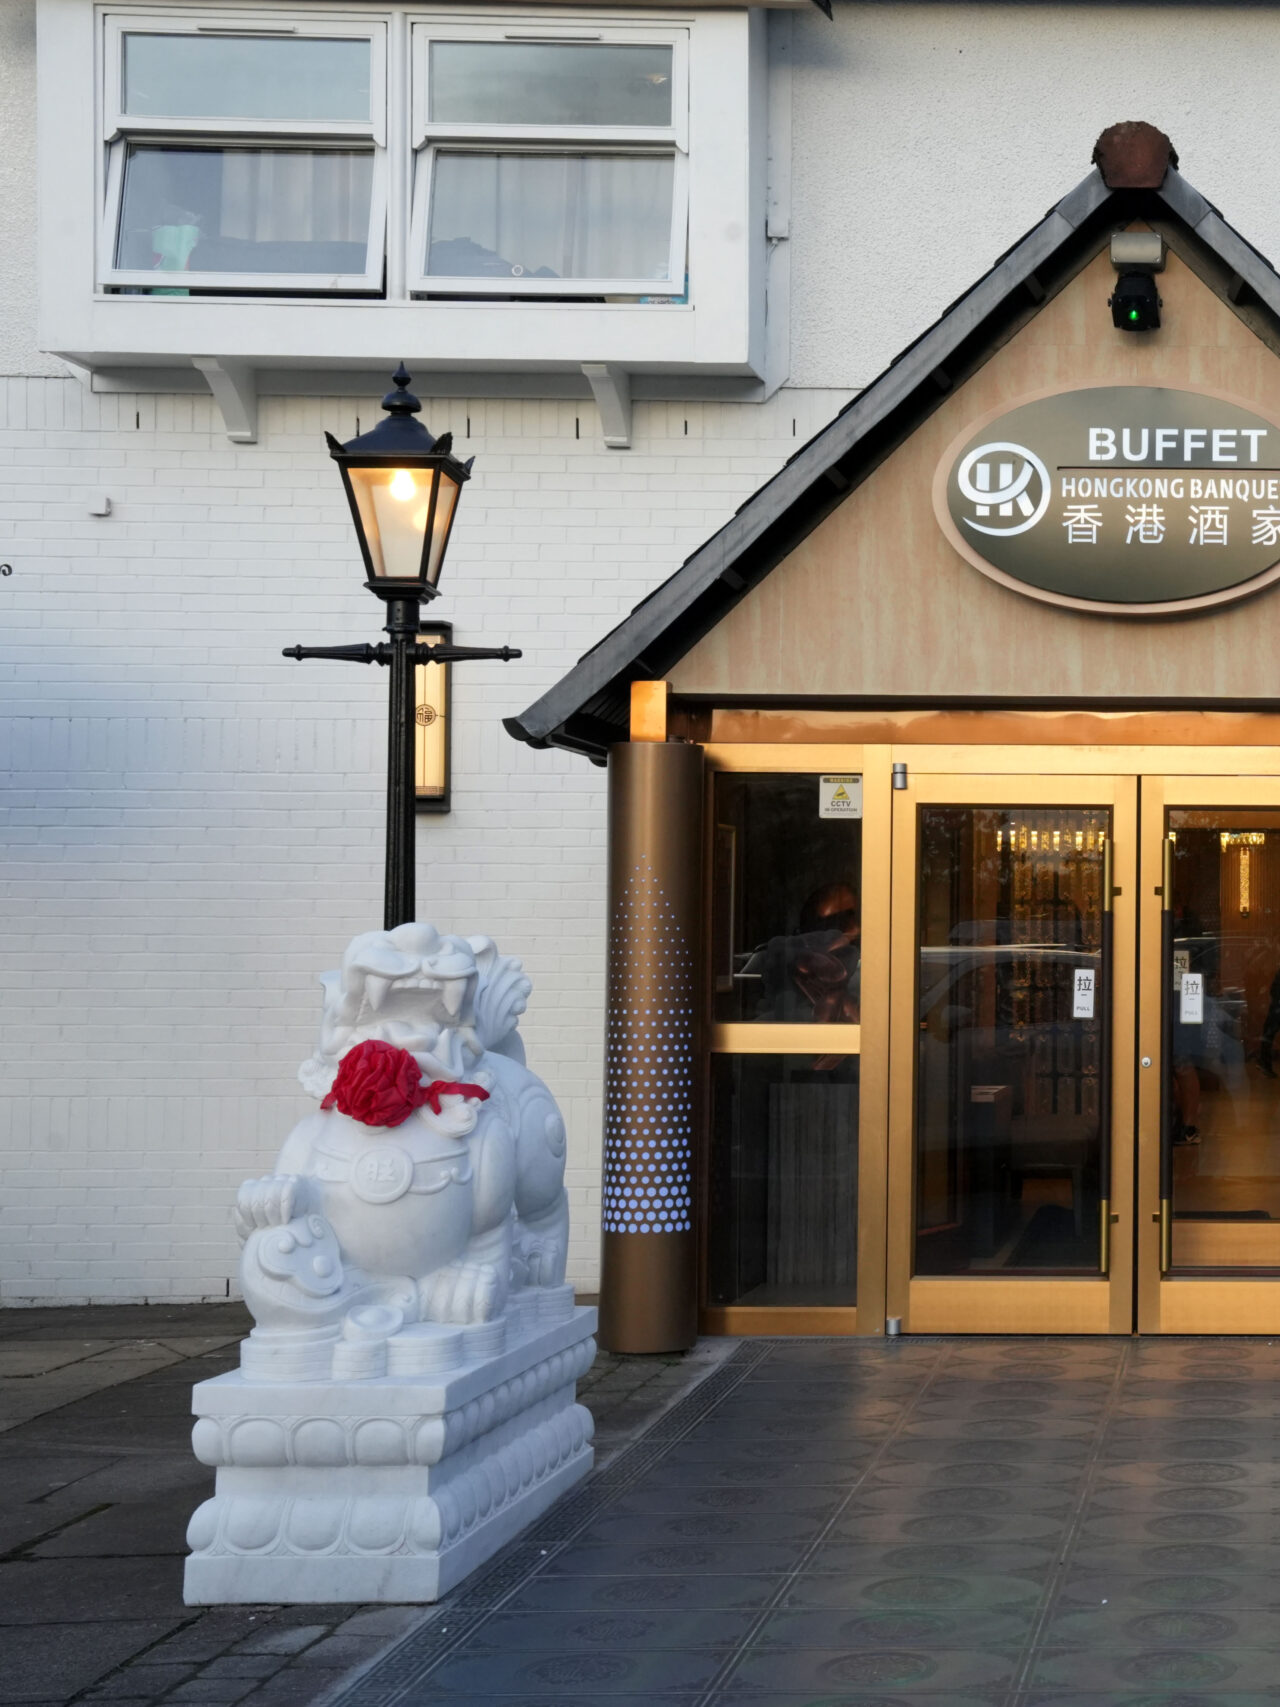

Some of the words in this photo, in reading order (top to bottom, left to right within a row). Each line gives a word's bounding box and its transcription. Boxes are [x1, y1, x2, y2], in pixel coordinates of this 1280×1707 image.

[1088, 427, 1268, 463] BUFFET
[1061, 476, 1184, 499] HONGKONG
[1077, 976, 1093, 992] 拉
[1184, 980, 1200, 996] 拉
